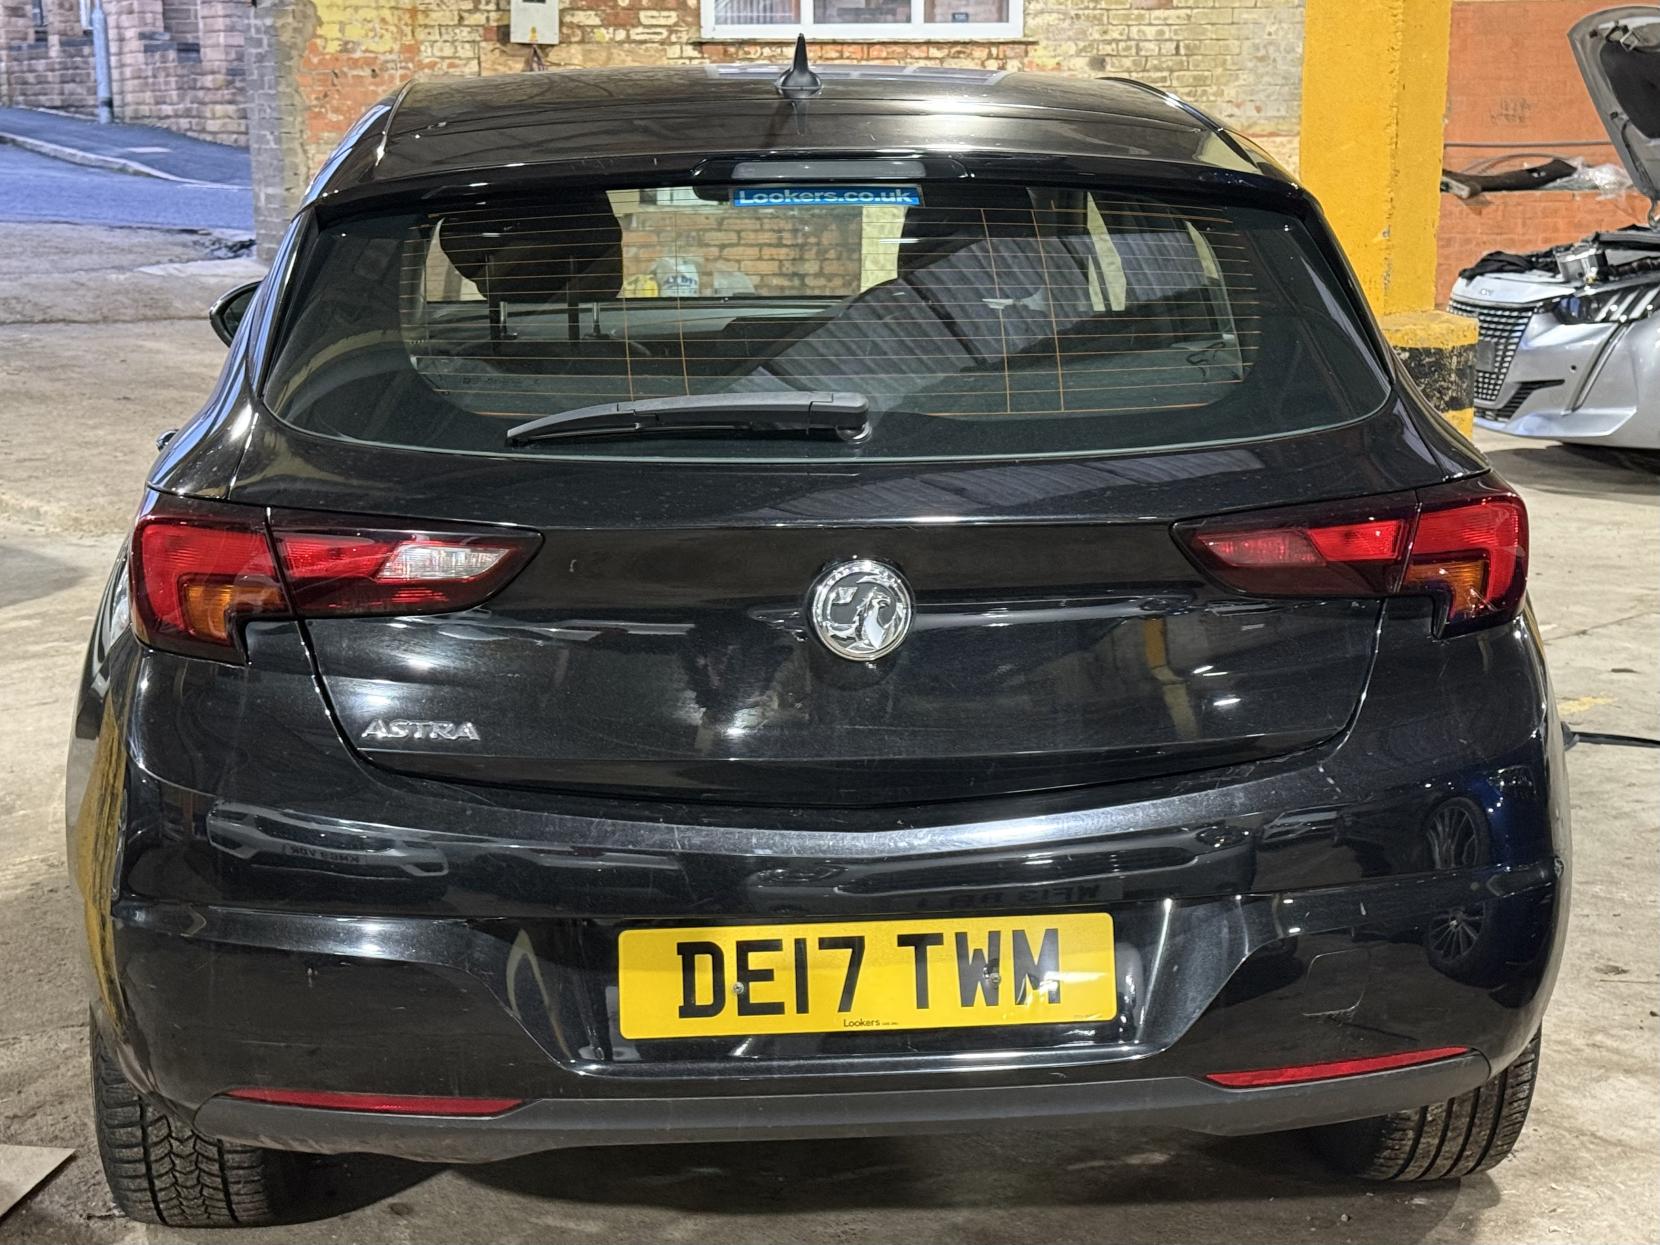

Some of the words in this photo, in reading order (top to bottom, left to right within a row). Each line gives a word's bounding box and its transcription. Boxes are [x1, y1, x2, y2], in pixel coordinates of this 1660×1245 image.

[738, 188, 913, 204] Lookers.co.uk
[361, 719, 480, 740] ASTRA
[676, 934, 866, 1019] DE17
[897, 928, 1060, 1010] TWM
[843, 1018, 881, 1028] Lookers
